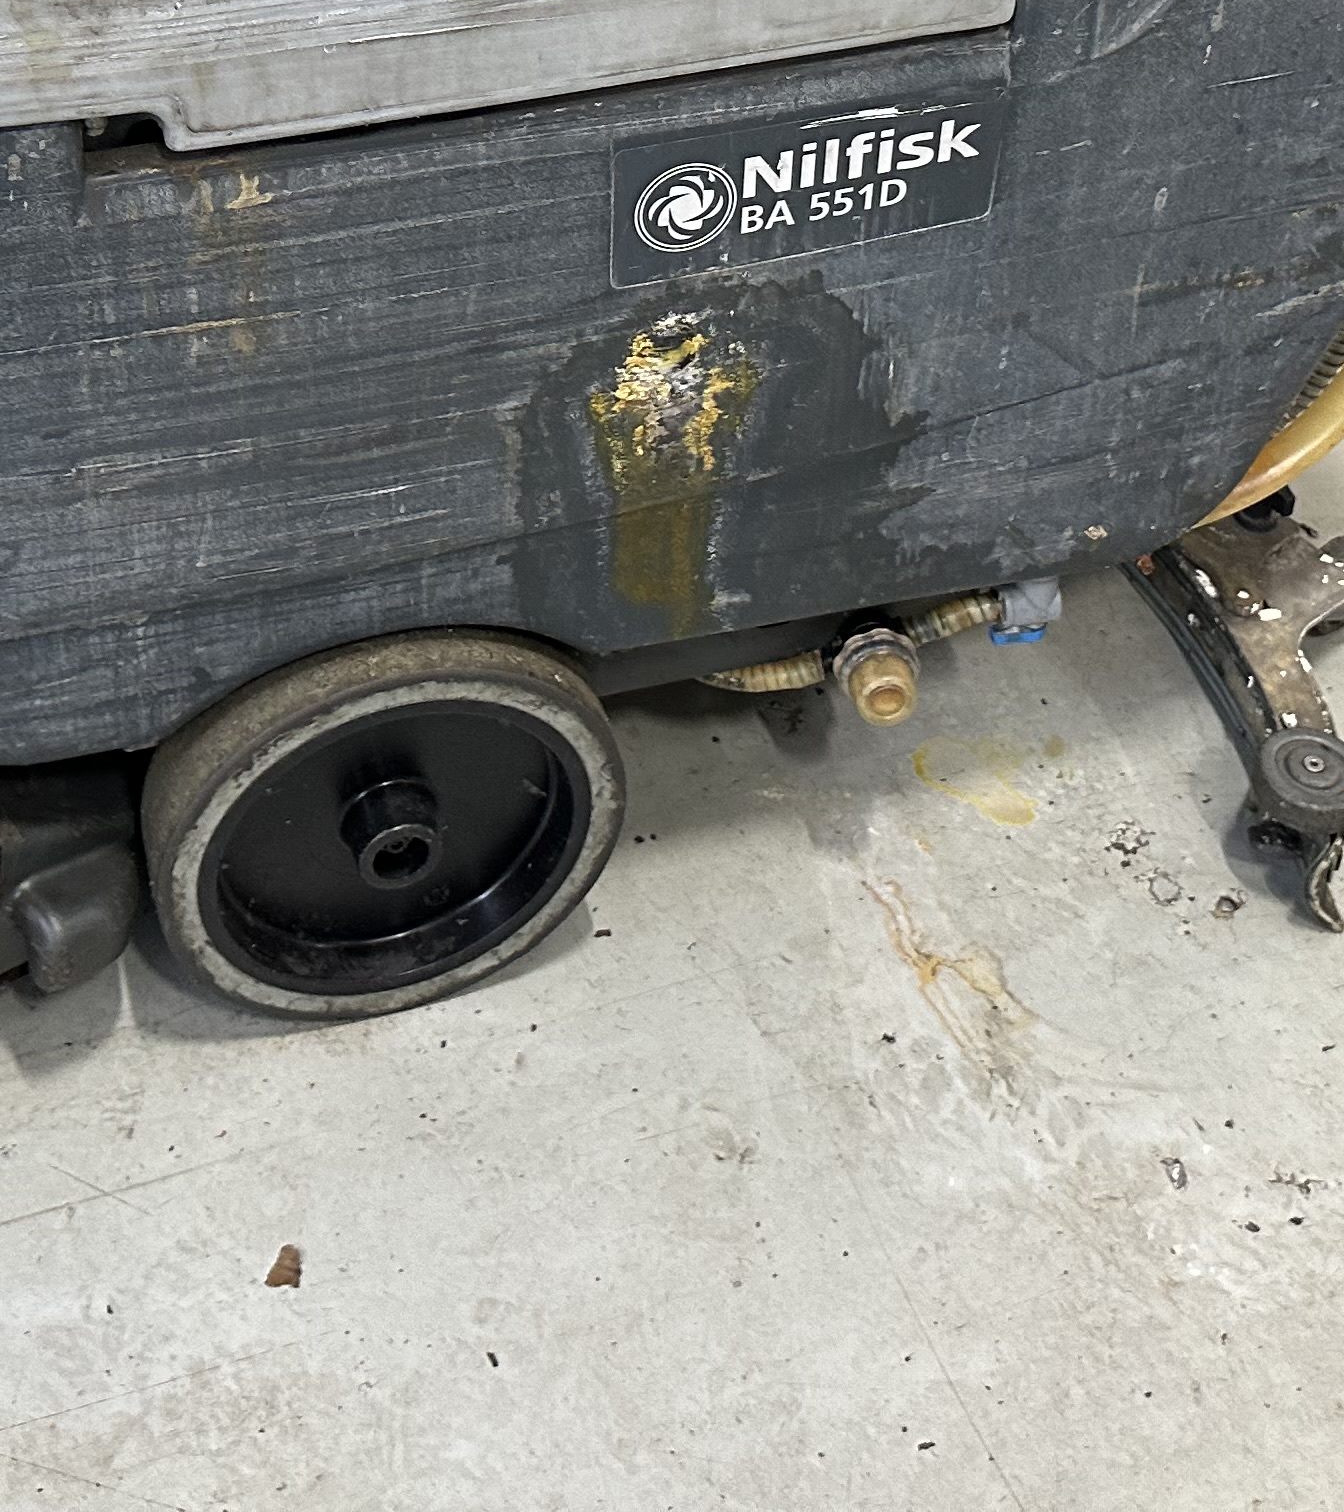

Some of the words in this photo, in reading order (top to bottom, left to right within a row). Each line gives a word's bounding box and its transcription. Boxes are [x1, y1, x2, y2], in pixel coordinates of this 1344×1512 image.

[742, 119, 981, 198] Nilfisk
[740, 204, 795, 234] BA
[808, 178, 907, 221] 551D
